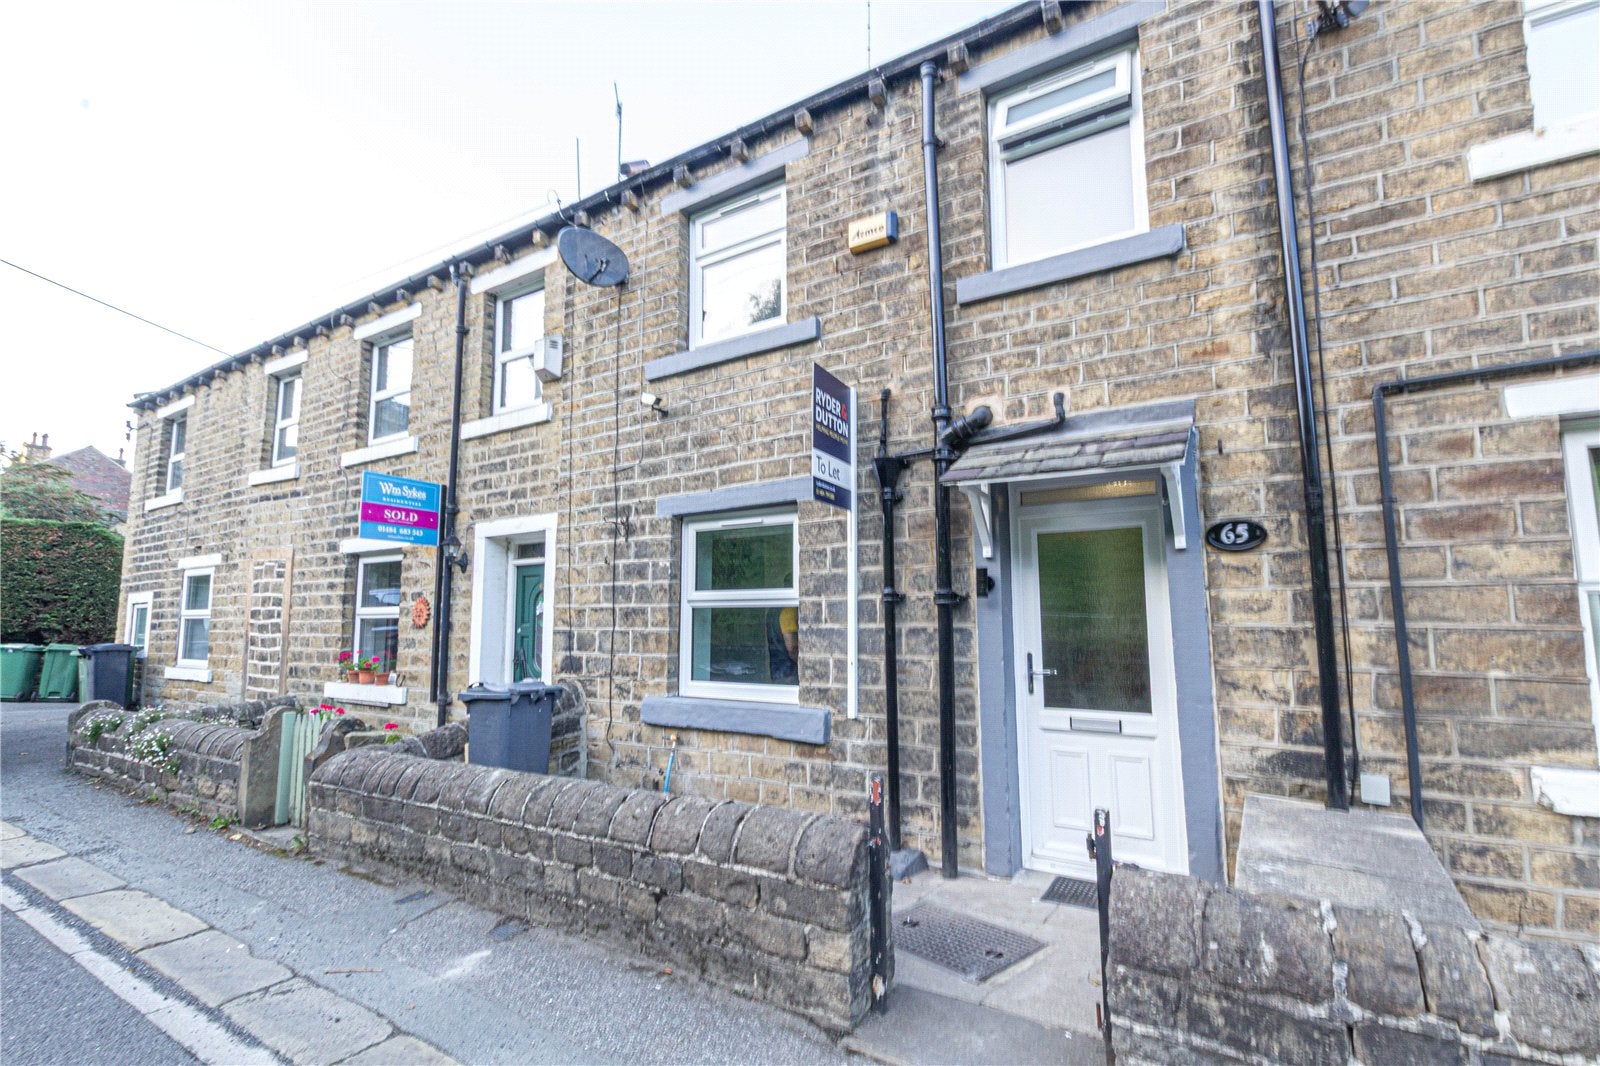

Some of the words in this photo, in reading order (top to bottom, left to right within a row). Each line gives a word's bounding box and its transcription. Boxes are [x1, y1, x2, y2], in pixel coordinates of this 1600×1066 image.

[815, 386, 841, 418] RYDER
[815, 405, 849, 438] DUTTON
[816, 454, 826, 475] To
[828, 460, 840, 481] Let
[379, 481, 400, 496] Wm
[402, 485, 426, 500] Sykes
[384, 509, 418, 522] SOLD
[1220, 522, 1249, 545] 65
